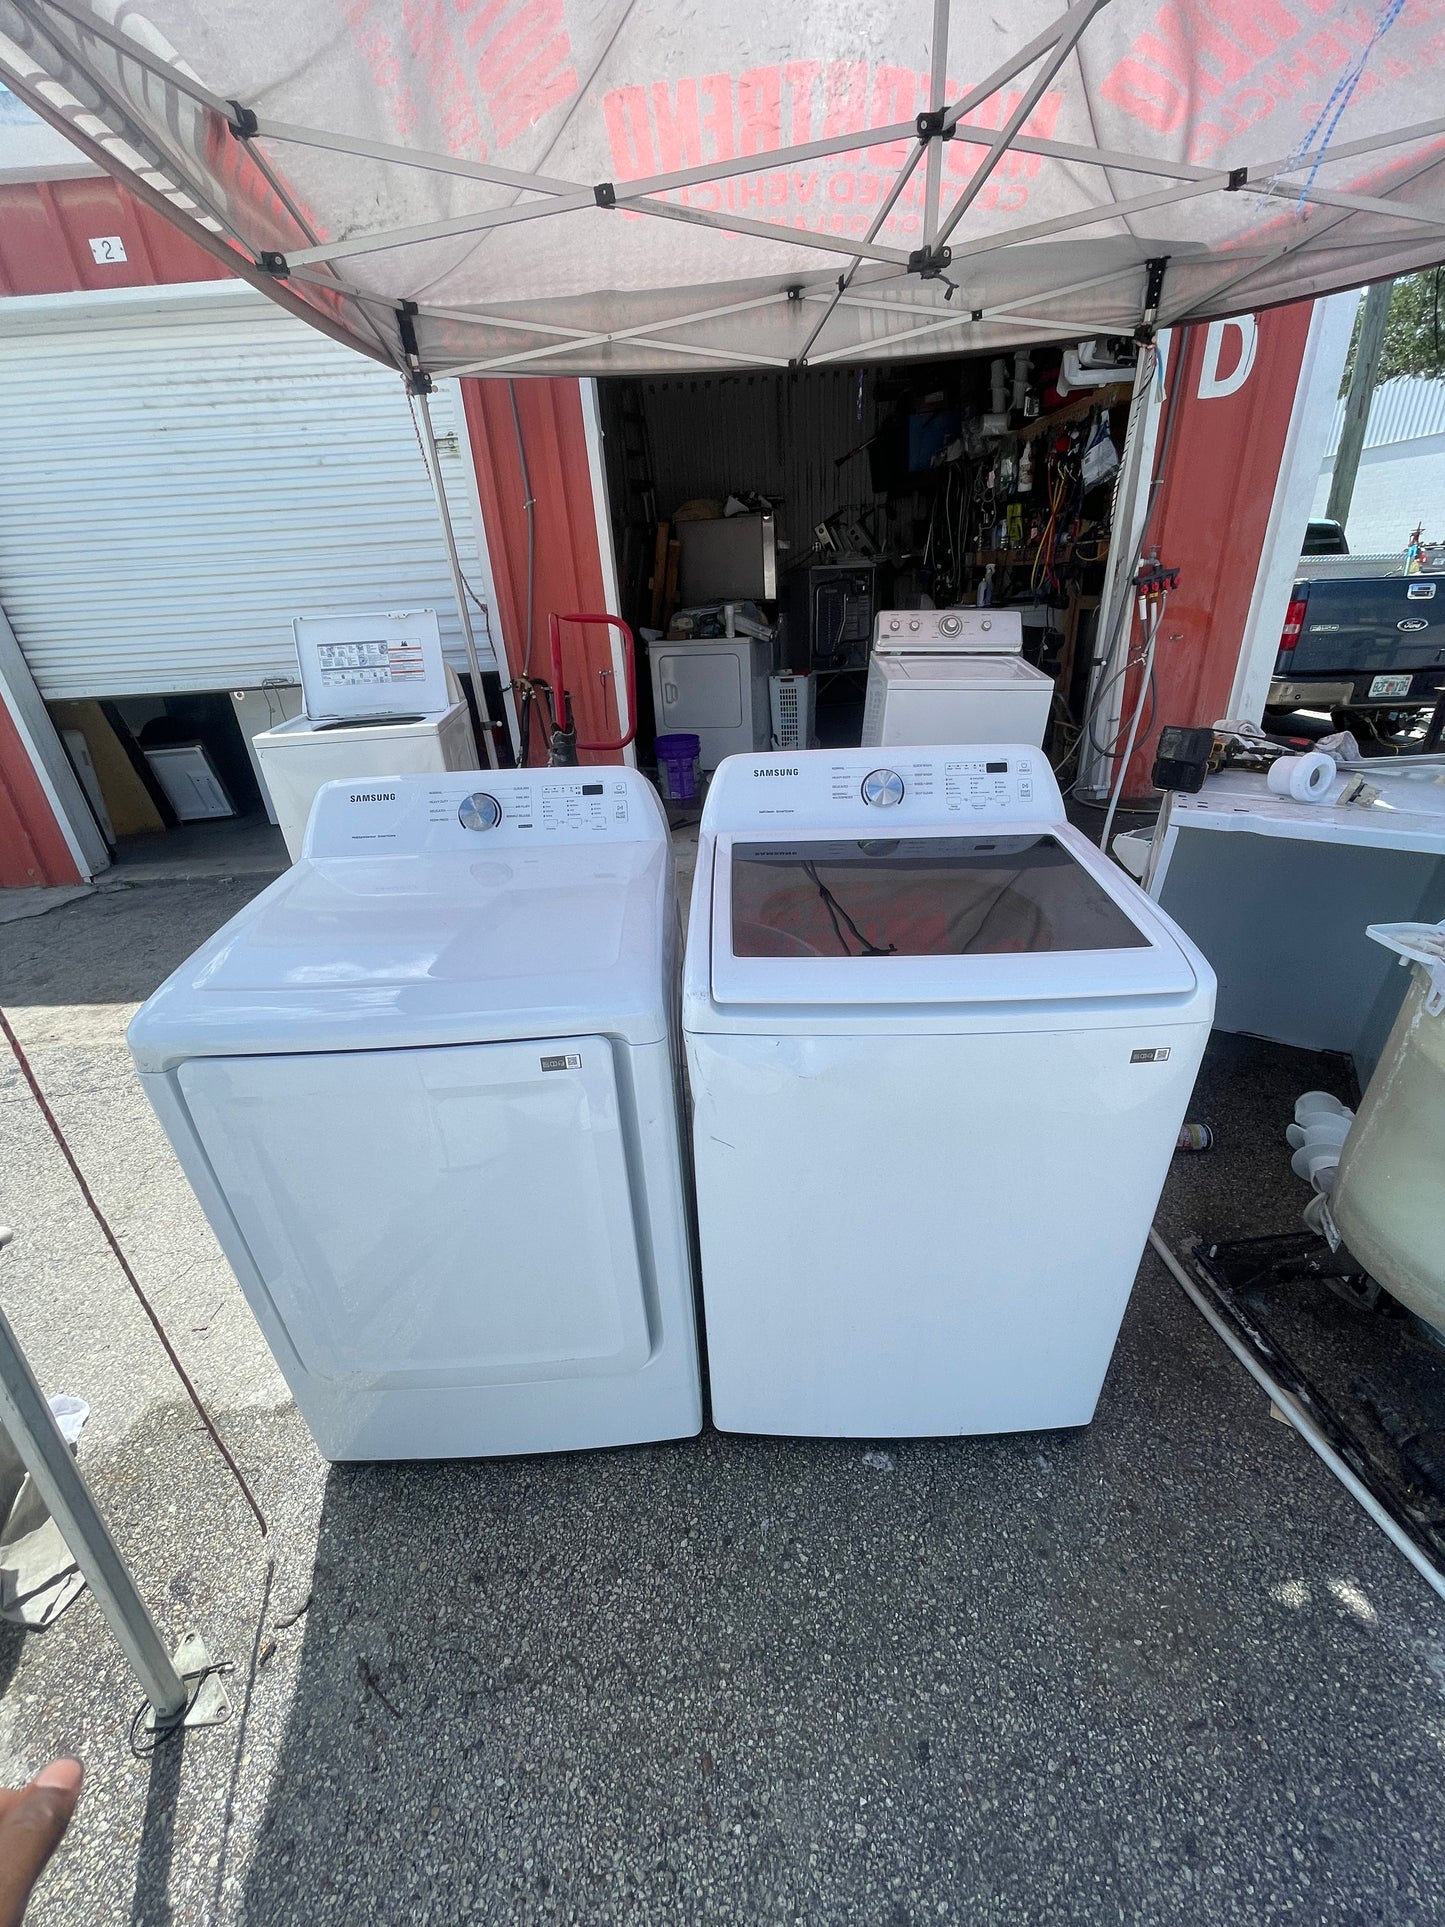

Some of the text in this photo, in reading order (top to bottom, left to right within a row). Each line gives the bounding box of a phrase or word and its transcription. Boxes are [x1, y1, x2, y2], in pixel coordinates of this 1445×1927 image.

[102, 240, 115, 259] 2
[1197, 313, 1258, 399] D
[753, 768, 799, 777] SAMSUNG
[350, 793, 396, 803] SAMSUNG
